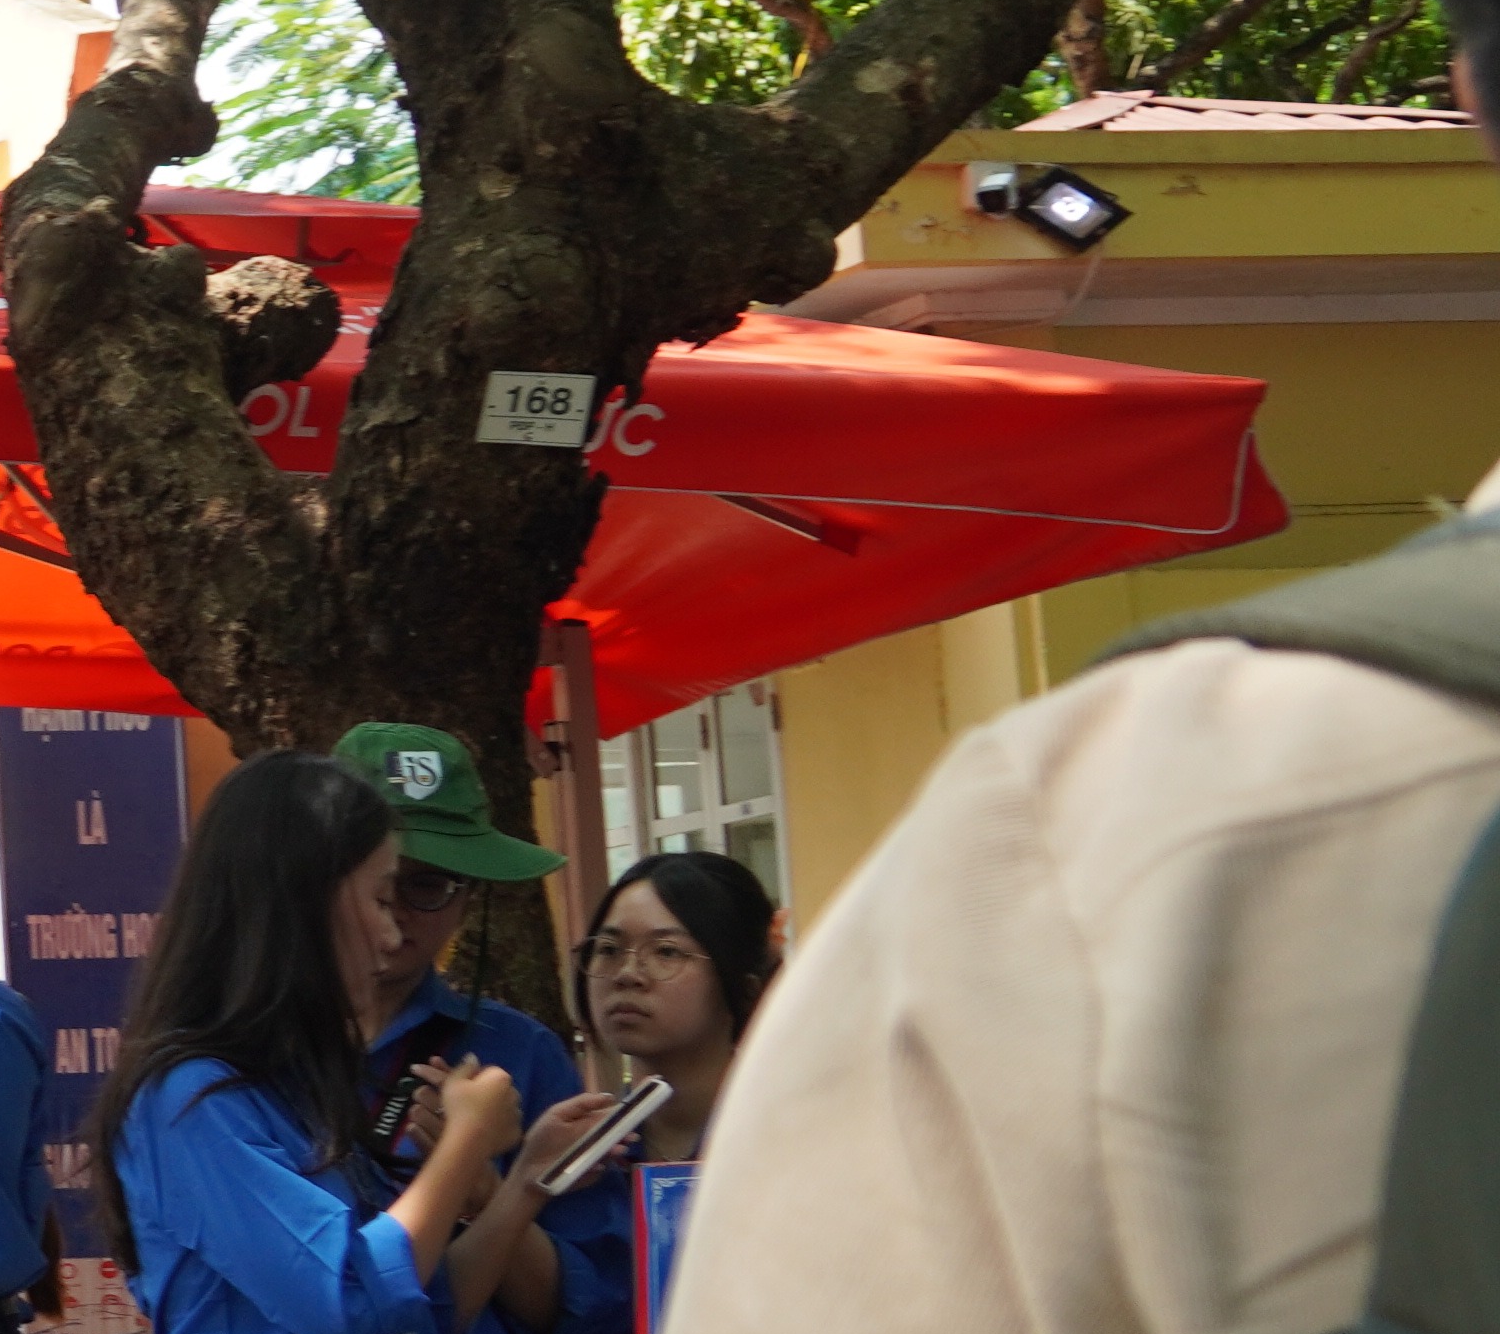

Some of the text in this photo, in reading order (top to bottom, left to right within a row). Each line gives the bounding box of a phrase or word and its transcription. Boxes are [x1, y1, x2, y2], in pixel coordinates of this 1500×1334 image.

[240, 383, 321, 437] OL
[506, 386, 573, 415] 168
[54, 1028, 90, 1074] AN
